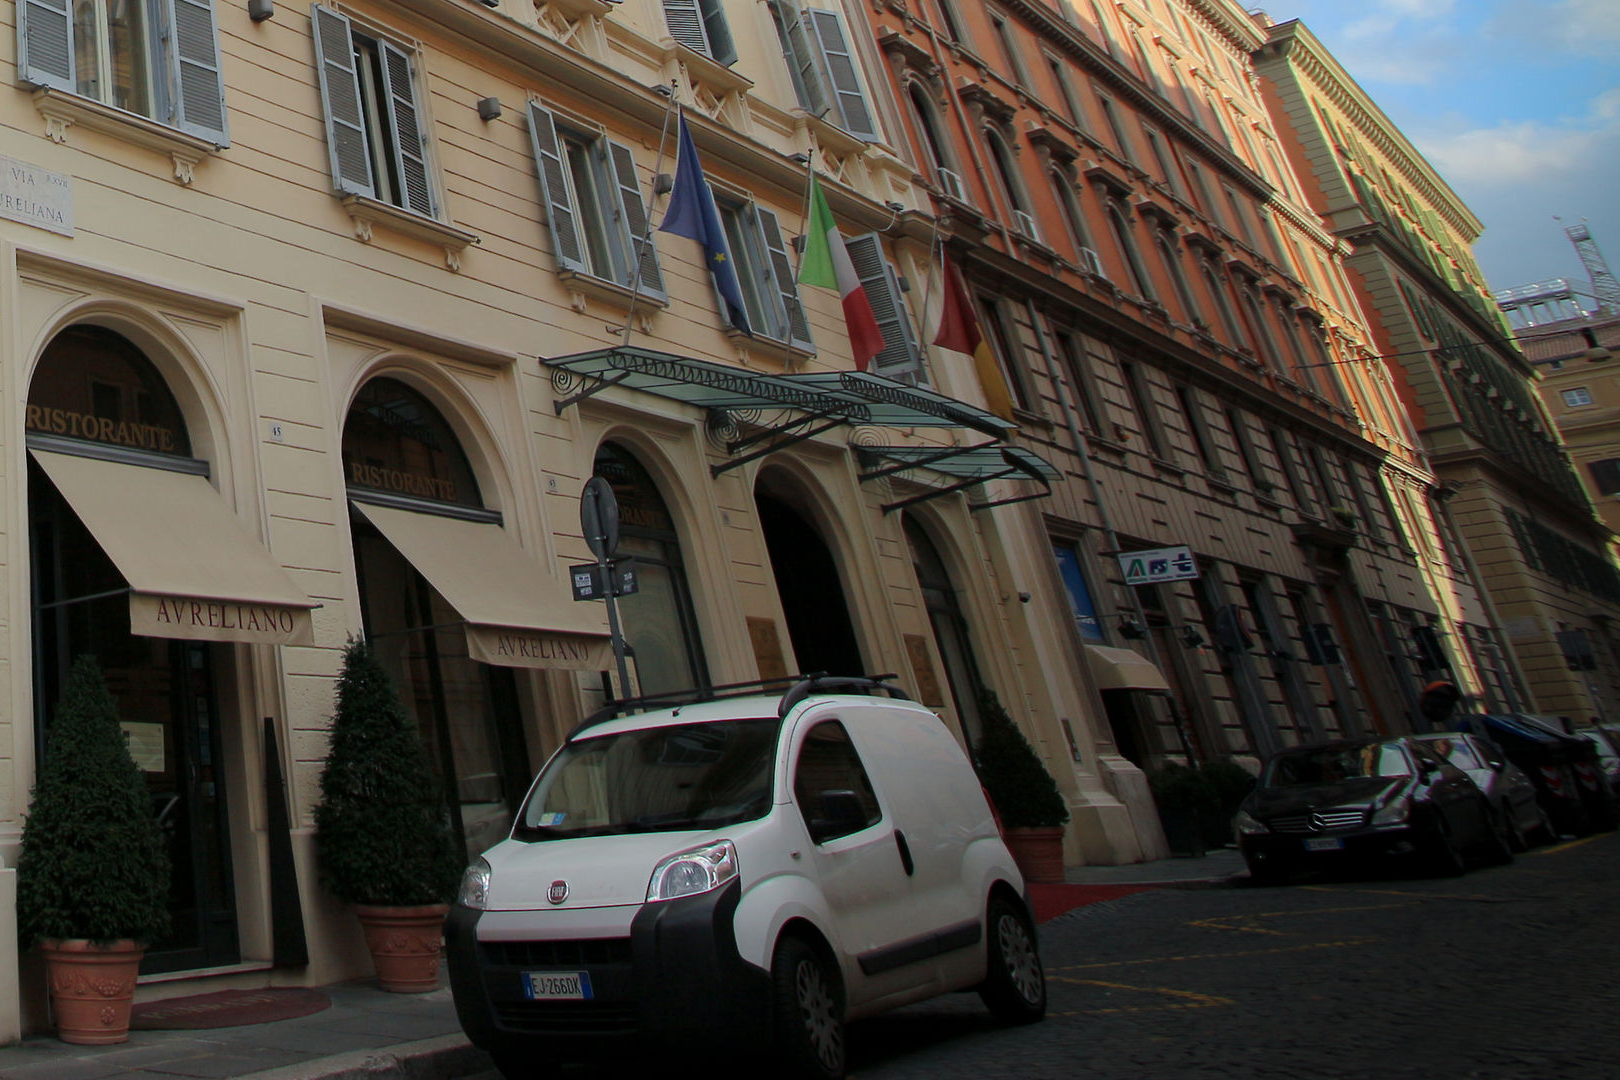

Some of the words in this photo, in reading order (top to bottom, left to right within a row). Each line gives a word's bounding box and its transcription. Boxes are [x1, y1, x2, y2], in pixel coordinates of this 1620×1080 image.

[11, 167, 35, 186] VIA
[26, 404, 175, 452] RISTORANTE
[351, 462, 458, 502] RISTORANTE
[157, 599, 295, 634] AVRELIANO
[497, 635, 589, 662] AVRELIANO
[552, 886, 565, 897] FIAT
